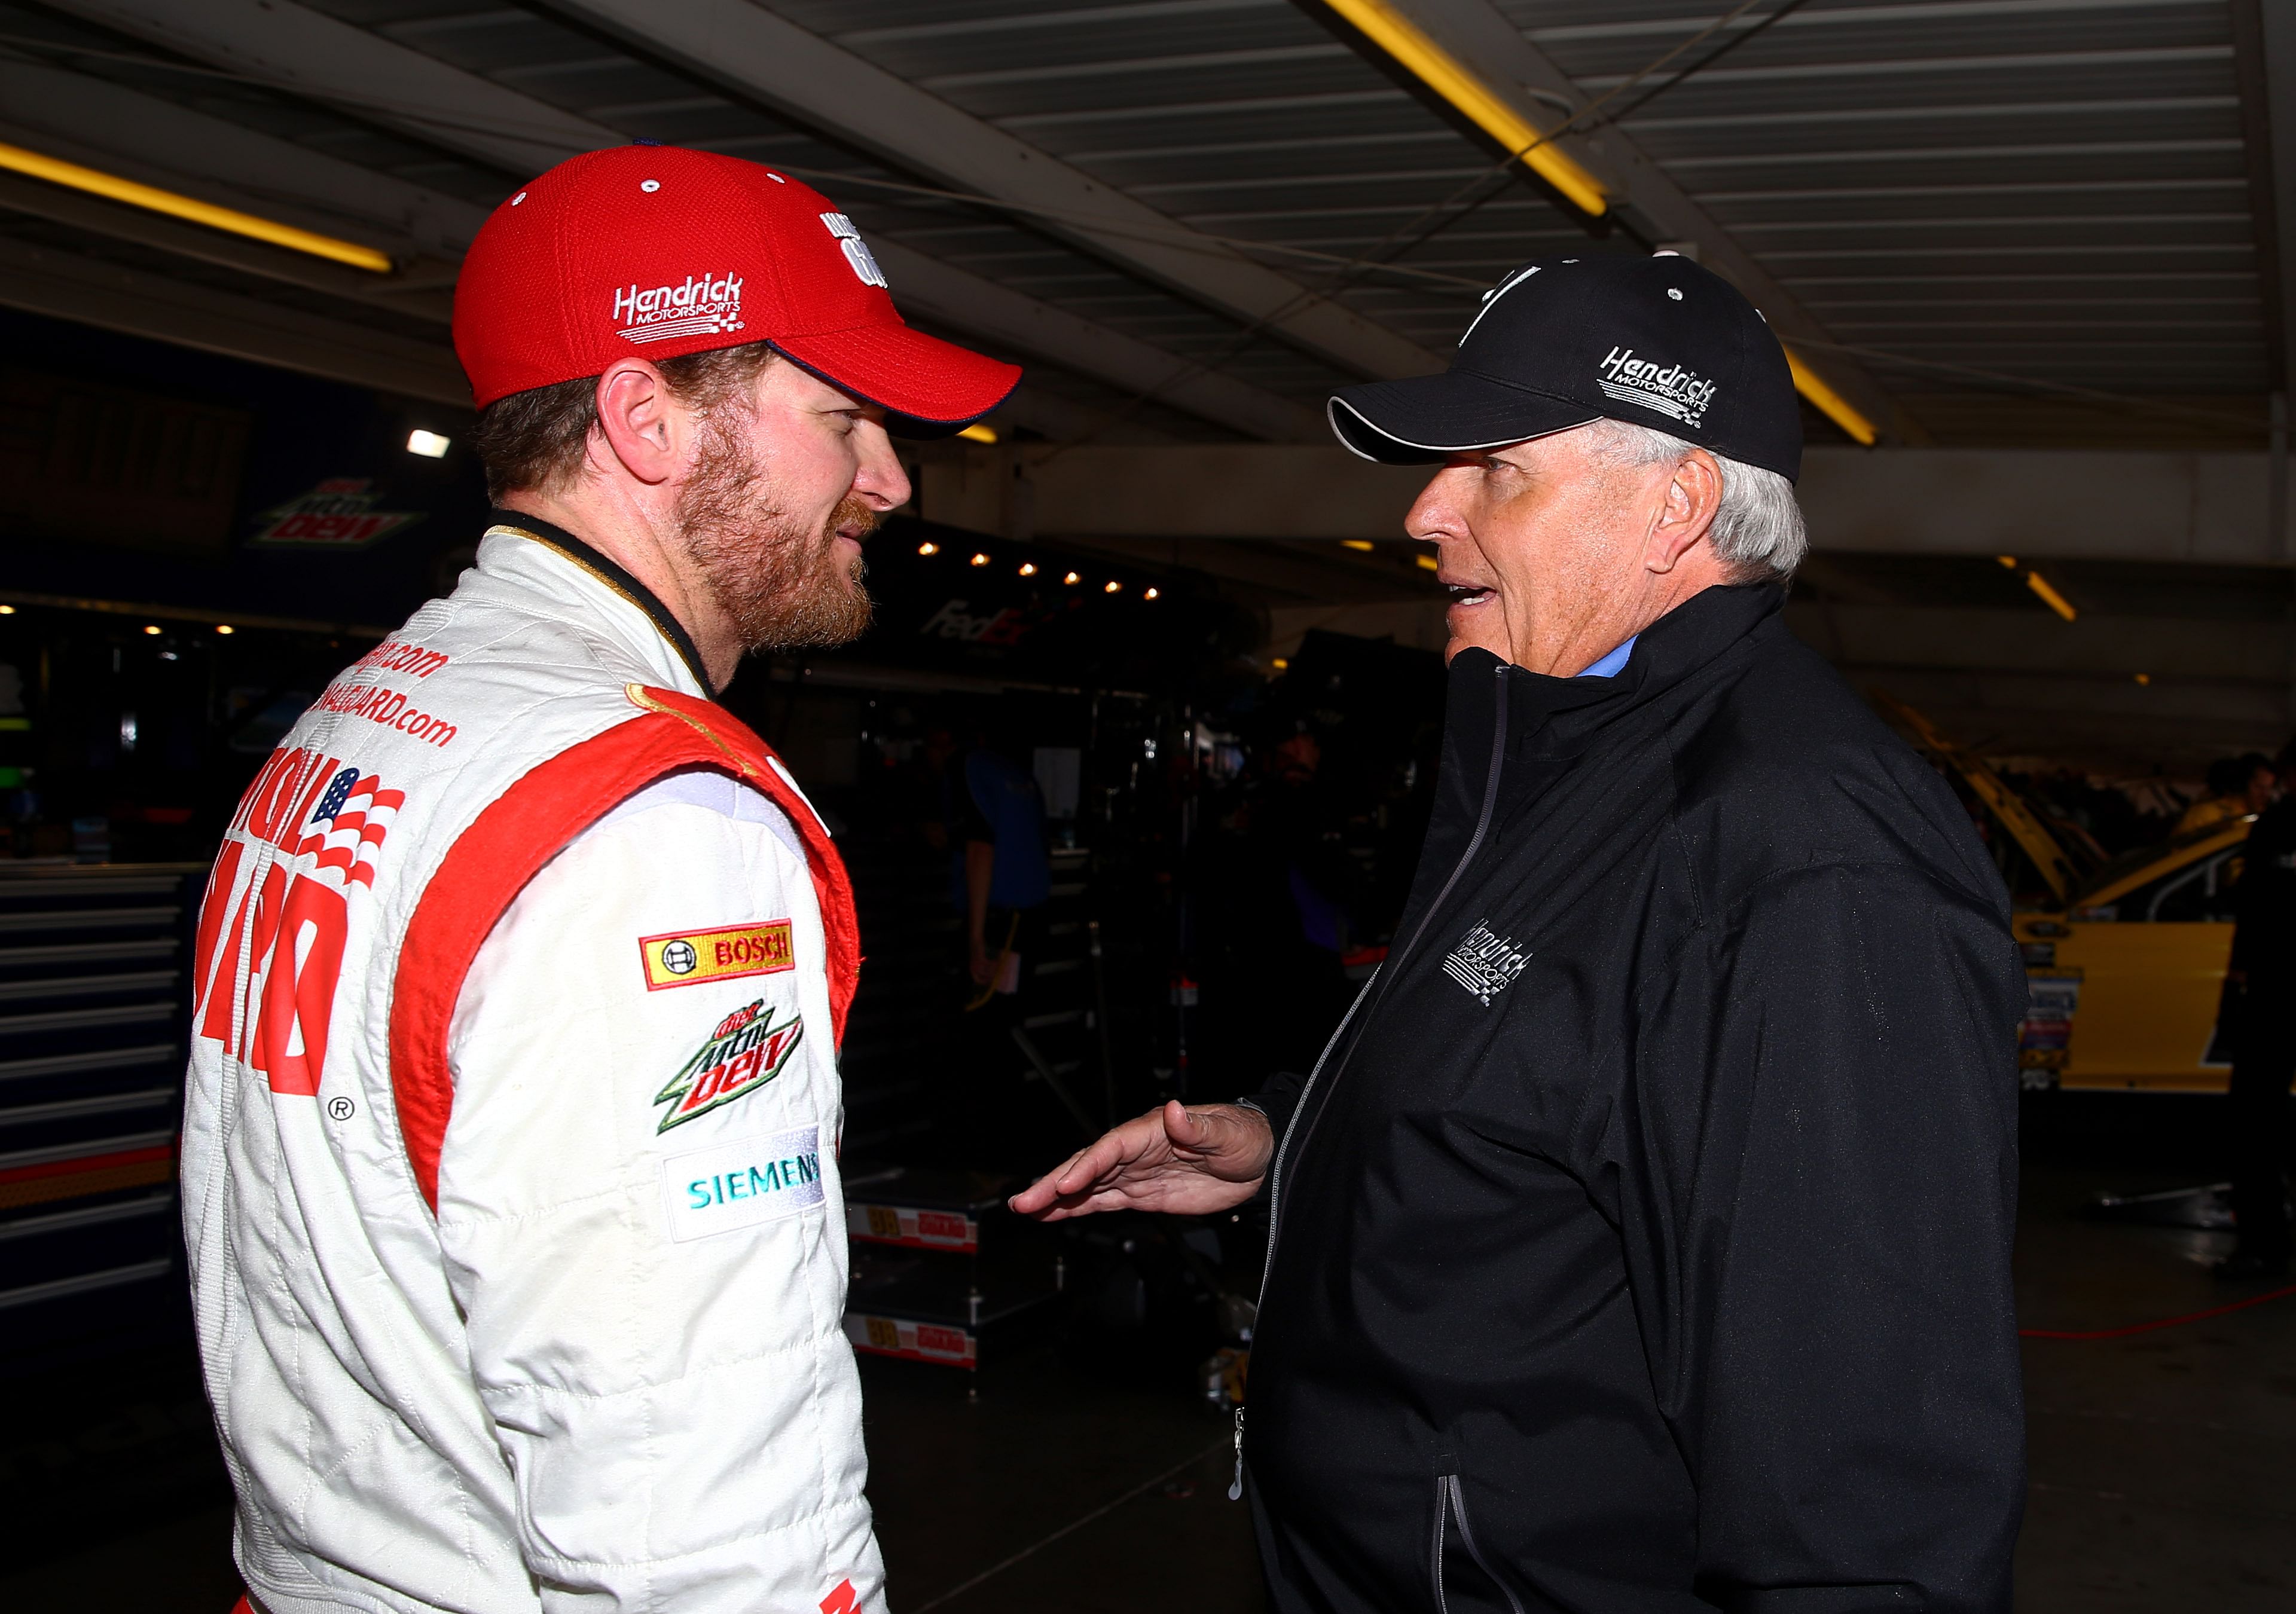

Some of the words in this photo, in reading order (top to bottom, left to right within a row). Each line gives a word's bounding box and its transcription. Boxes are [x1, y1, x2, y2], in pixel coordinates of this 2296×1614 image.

[612, 271, 744, 326] Hendrick
[636, 301, 741, 325] MOTORSPORTS
[1599, 346, 1718, 404] Hendrick
[1615, 374, 1709, 412] MOTORSPORTS
[715, 931, 790, 967] BOSCH
